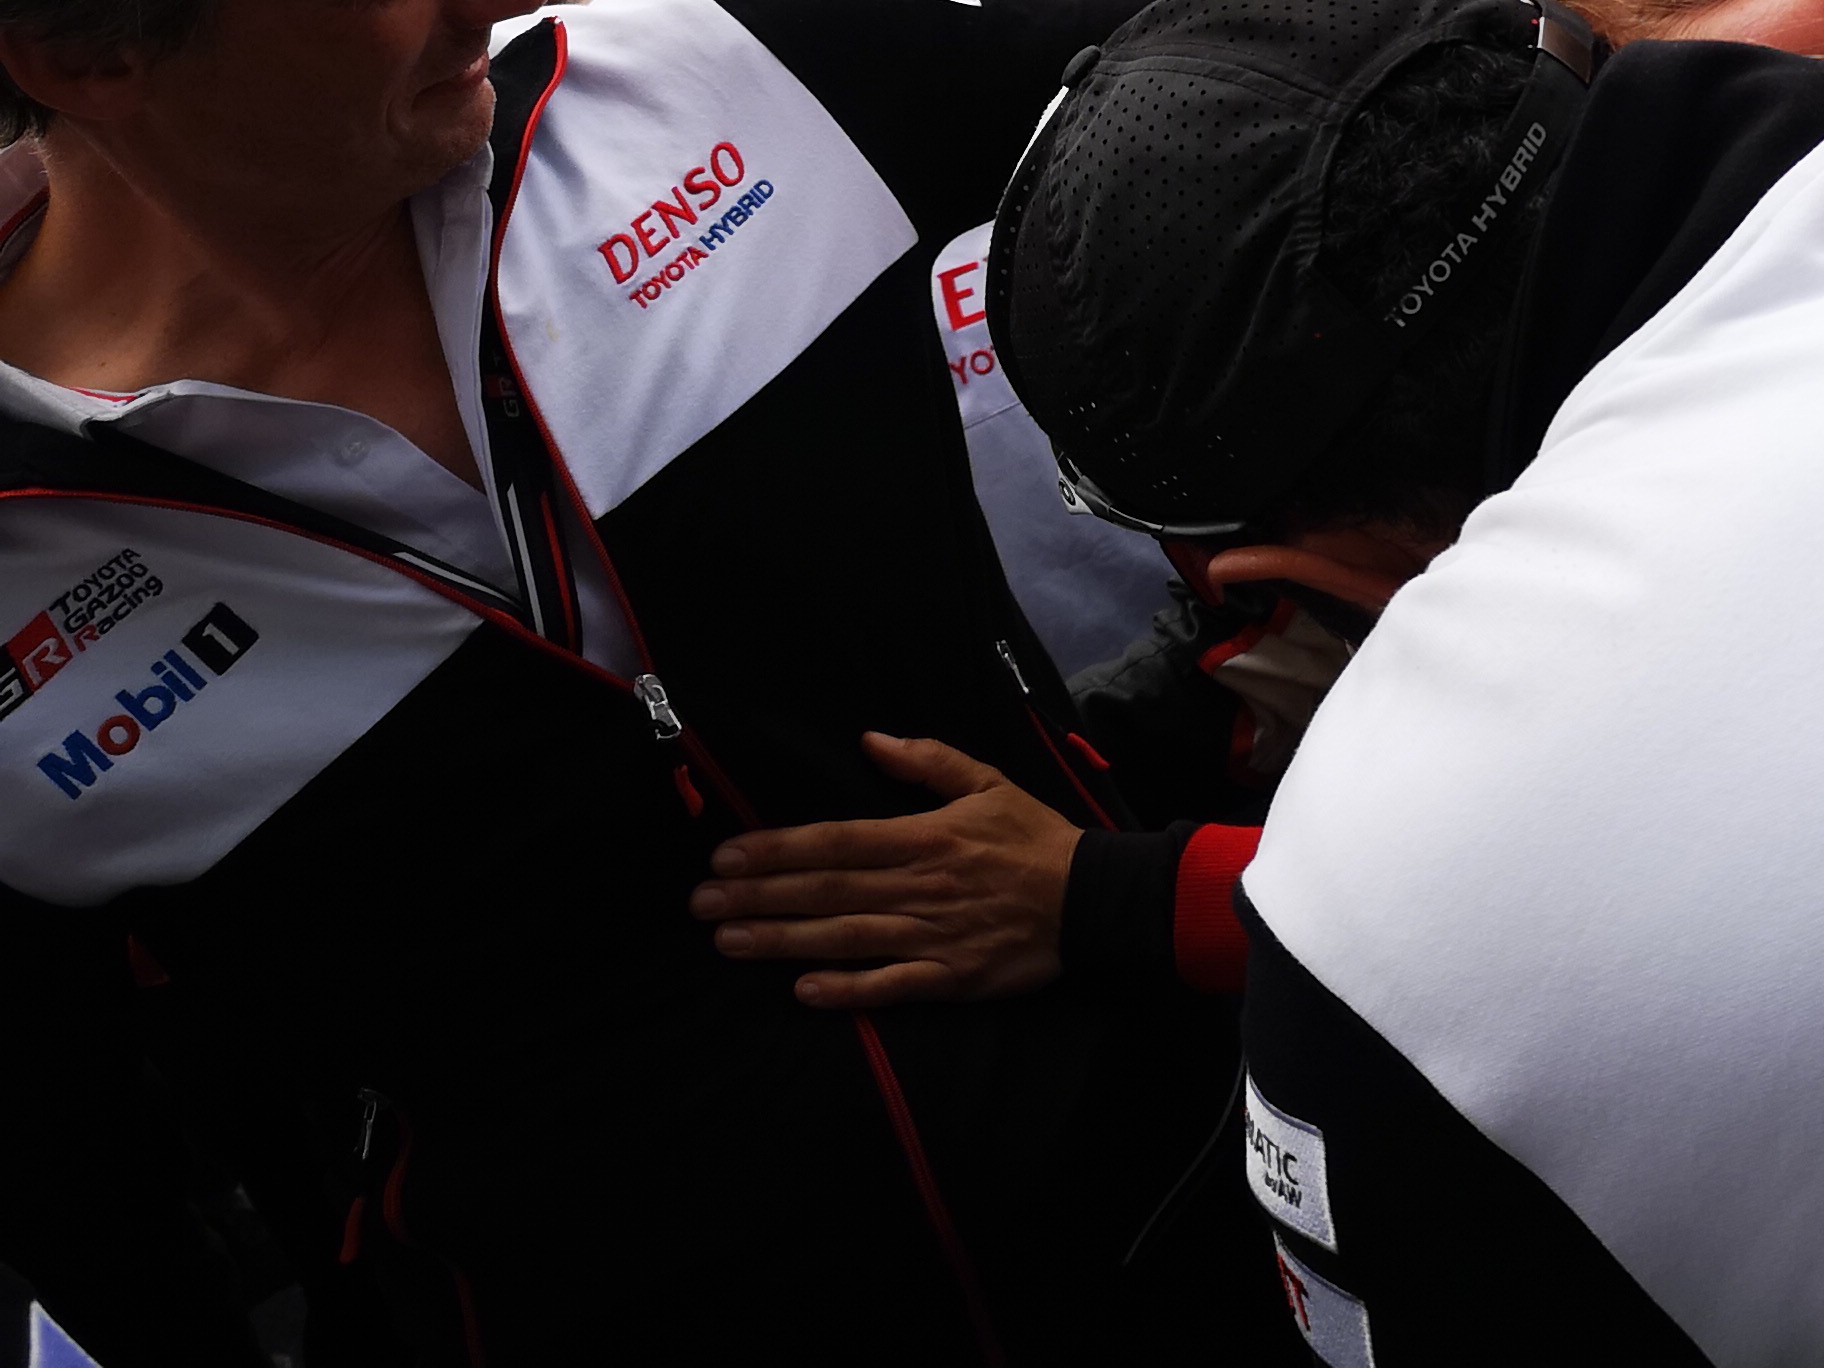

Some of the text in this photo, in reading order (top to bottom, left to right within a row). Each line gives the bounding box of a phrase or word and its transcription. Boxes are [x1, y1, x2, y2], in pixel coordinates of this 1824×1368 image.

[597, 141, 745, 285] DENSO
[628, 179, 775, 310] TOYOTA HYBRID
[1383, 121, 1548, 328] TOYOTA HYBRID
[48, 547, 142, 617] TOYOTA
[63, 562, 150, 634] GAZOO
[72, 575, 165, 653] Racing
[36, 648, 209, 801] Mobil
